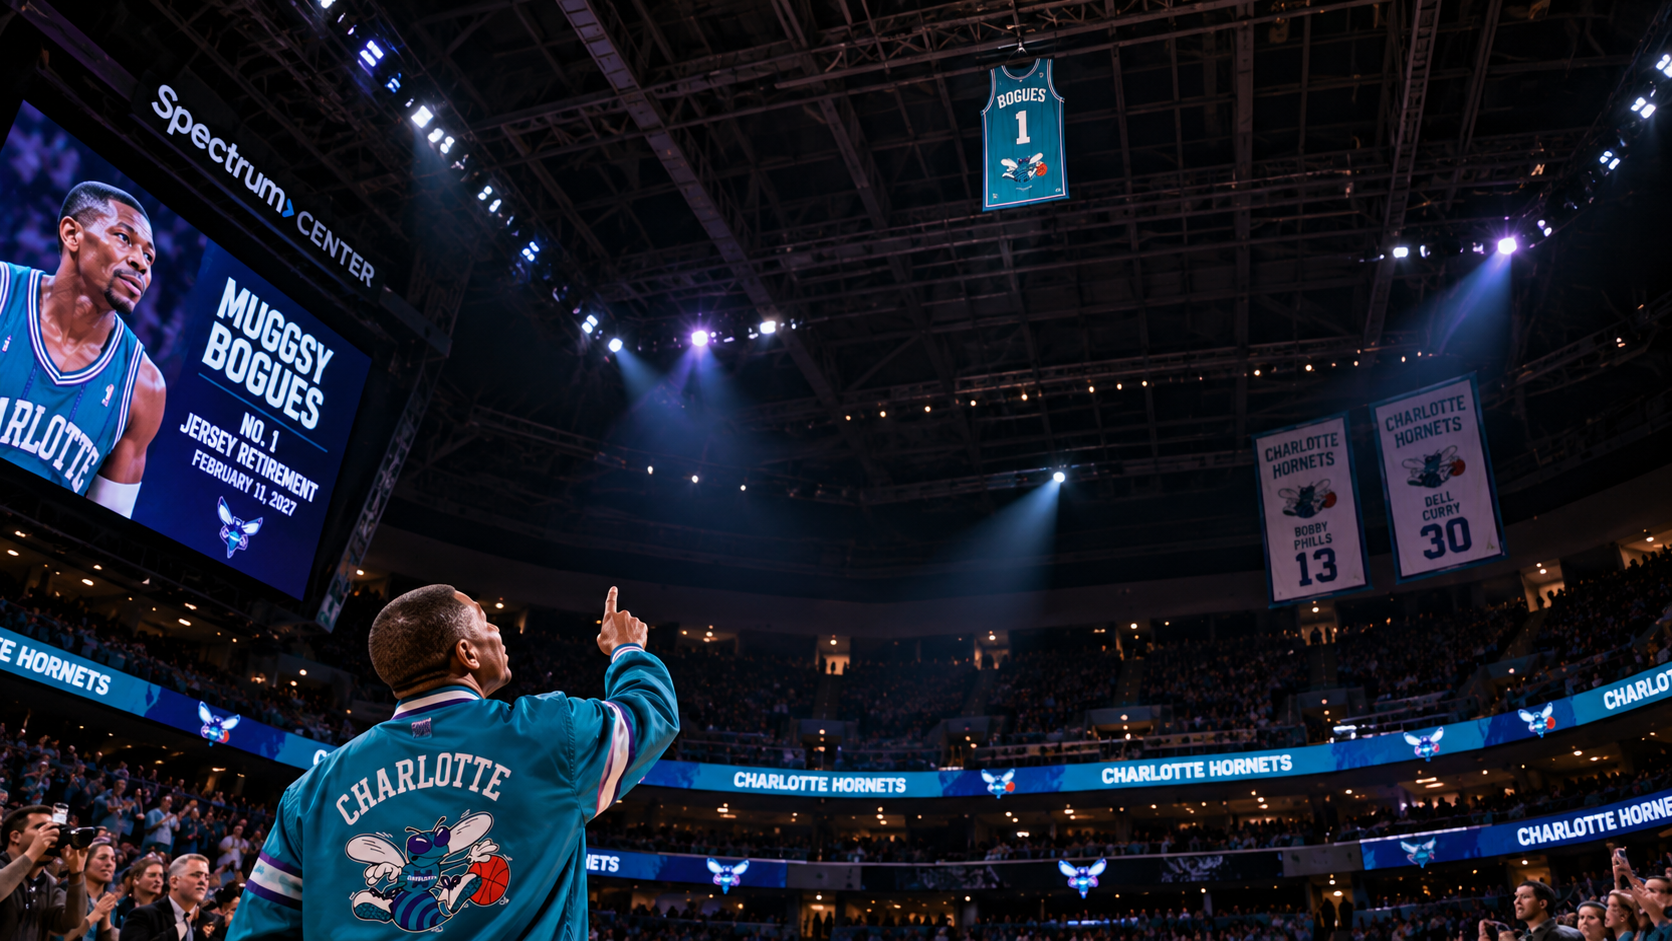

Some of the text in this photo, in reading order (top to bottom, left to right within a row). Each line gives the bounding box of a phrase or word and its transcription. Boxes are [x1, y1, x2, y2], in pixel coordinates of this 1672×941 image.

[996, 87, 1046, 109] BOGUES
[1015, 110, 1031, 145] 1
[151, 84, 375, 288] Spectrum CENTER
[216, 276, 334, 385] MUGGSY
[201, 320, 324, 430] BOGUES
[1385, 395, 1466, 432] CHARLOTTE
[239, 411, 279, 453] NO. 1
[1265, 432, 1339, 463] CHARLOTTE
[1394, 416, 1462, 449] HORNETS
[179, 412, 319, 502] JERSEY RETIREMENT
[1272, 451, 1335, 480] HORNETS
[191, 449, 297, 517] FEBRUARY 11, 2027
[1424, 490, 1454, 508] DELL
[1294, 521, 1328, 538] BOBBY
[1422, 502, 1460, 522] CURRY
[1294, 533, 1332, 550] PHILLS
[1420, 516, 1472, 560] 30
[1295, 548, 1337, 587] 13
[16, 645, 111, 696] HORNETS
[733, 771, 906, 794] CHARLOTTE HORNETS
[1101, 754, 1293, 785] CHARLOTTE HORNETS
[336, 752, 511, 825] CHARLOTTE
[1517, 811, 1617, 846] CHARLOTTE
